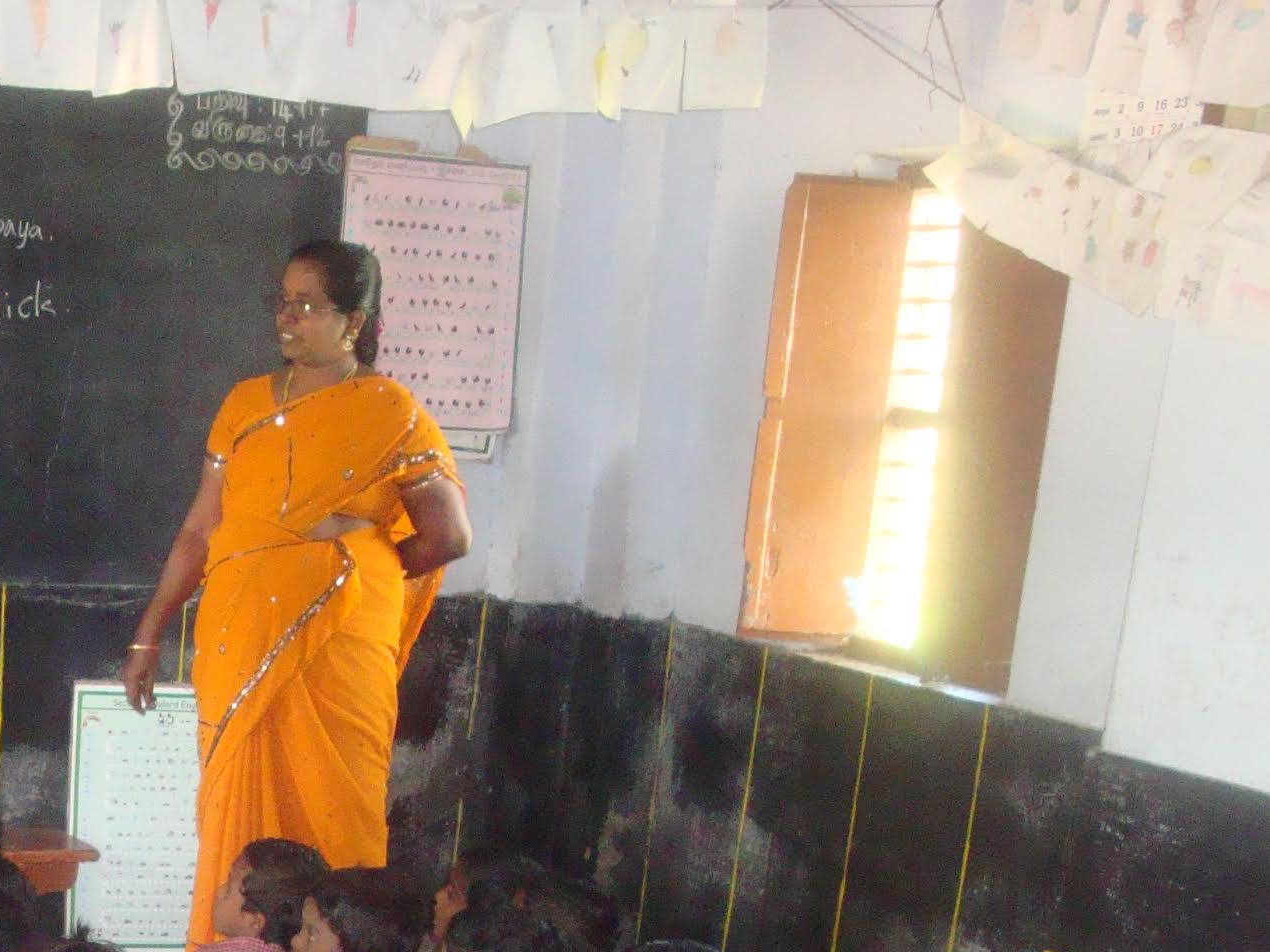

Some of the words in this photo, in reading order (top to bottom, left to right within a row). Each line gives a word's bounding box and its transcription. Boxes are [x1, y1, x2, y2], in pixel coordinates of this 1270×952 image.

[1155, 99, 1168, 111] 16
[1174, 97, 1189, 109] 23
[1131, 125, 1144, 137] 10
[1150, 124, 1164, 136] 17
